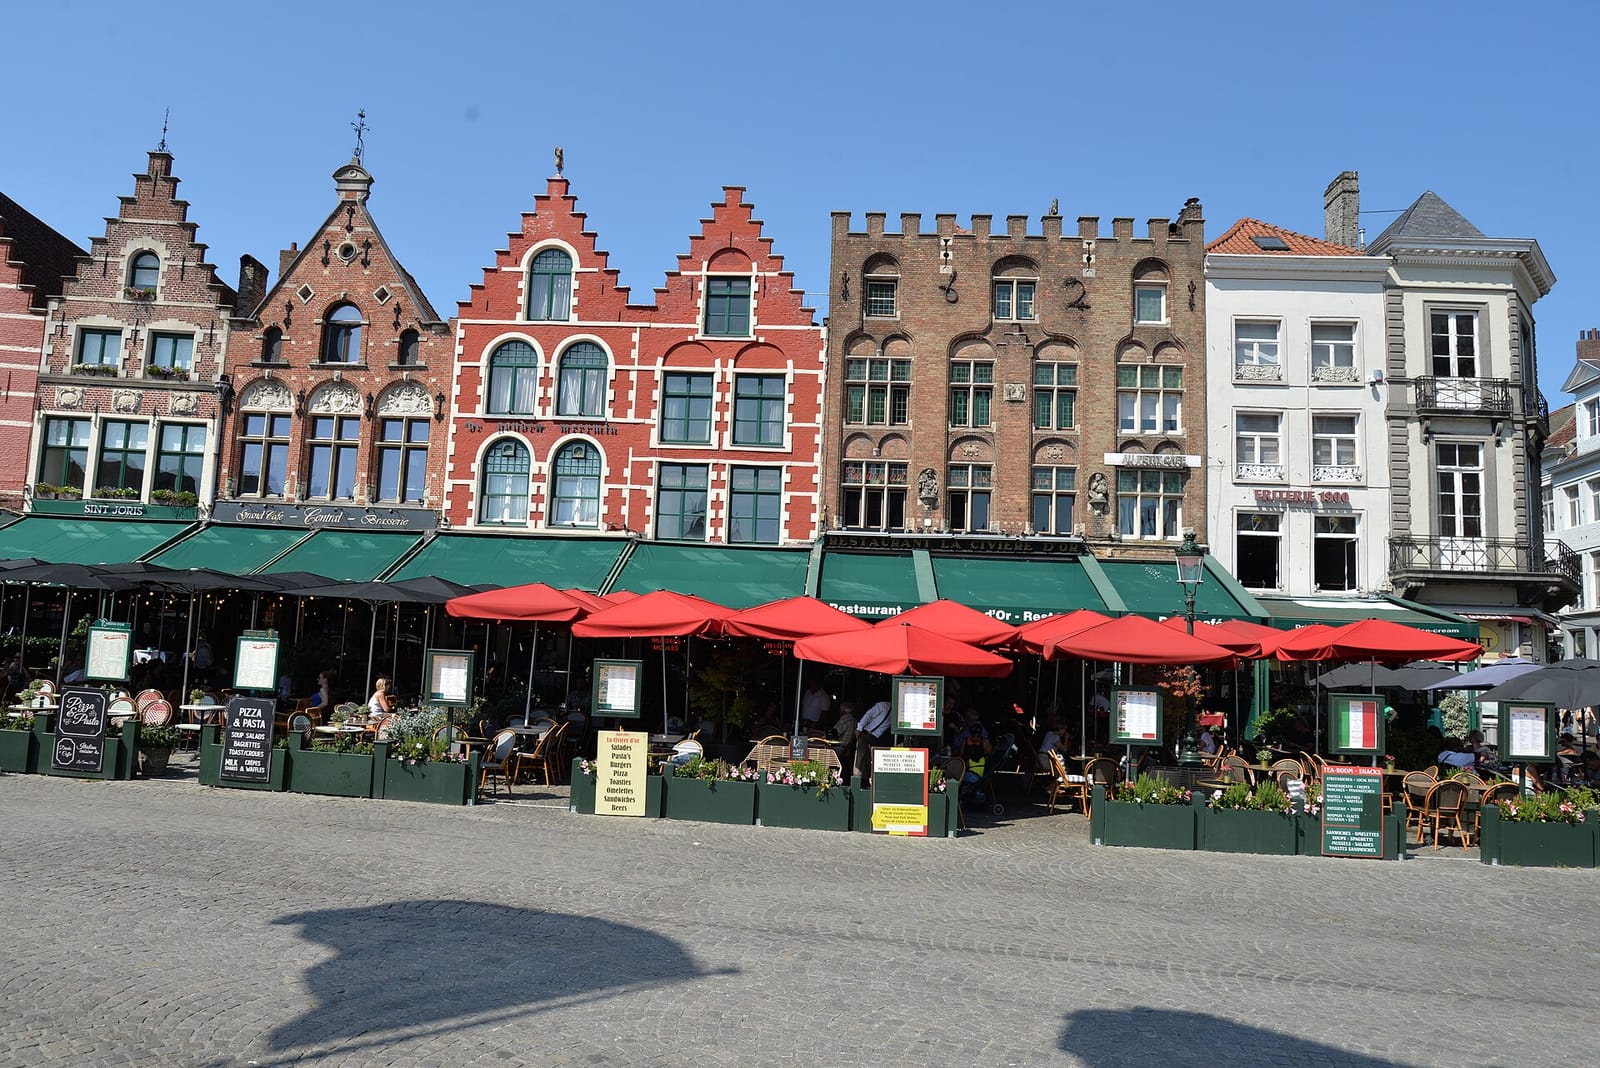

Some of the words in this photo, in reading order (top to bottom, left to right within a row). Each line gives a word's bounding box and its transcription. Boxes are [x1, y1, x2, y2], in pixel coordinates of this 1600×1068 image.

[1254, 489, 1315, 503] FRITERIE
[1318, 491, 1350, 504] 1900
[84, 504, 109, 514] SINT
[112, 505, 143, 516] JORIS
[304, 508, 343, 525] Central
[360, 514, 410, 527] Brasserie
[829, 536, 929, 549] RESTAURANT
[941, 540, 961, 549] LA
[829, 603, 902, 614] Restaurant
[66, 697, 95, 712] Pizza
[239, 707, 262, 717] PIZZA
[72, 713, 99, 725] Pasta
[233, 718, 240, 728] &
[242, 718, 266, 729] PASTA
[245, 732, 266, 740] SALADS
[224, 758, 238, 766] MILK
[610, 761, 632, 769] Burgers
[1359, 768, 1381, 776] SNACKS
[610, 778, 631, 786] Toasties
[604, 795, 636, 803] Sandwiches
